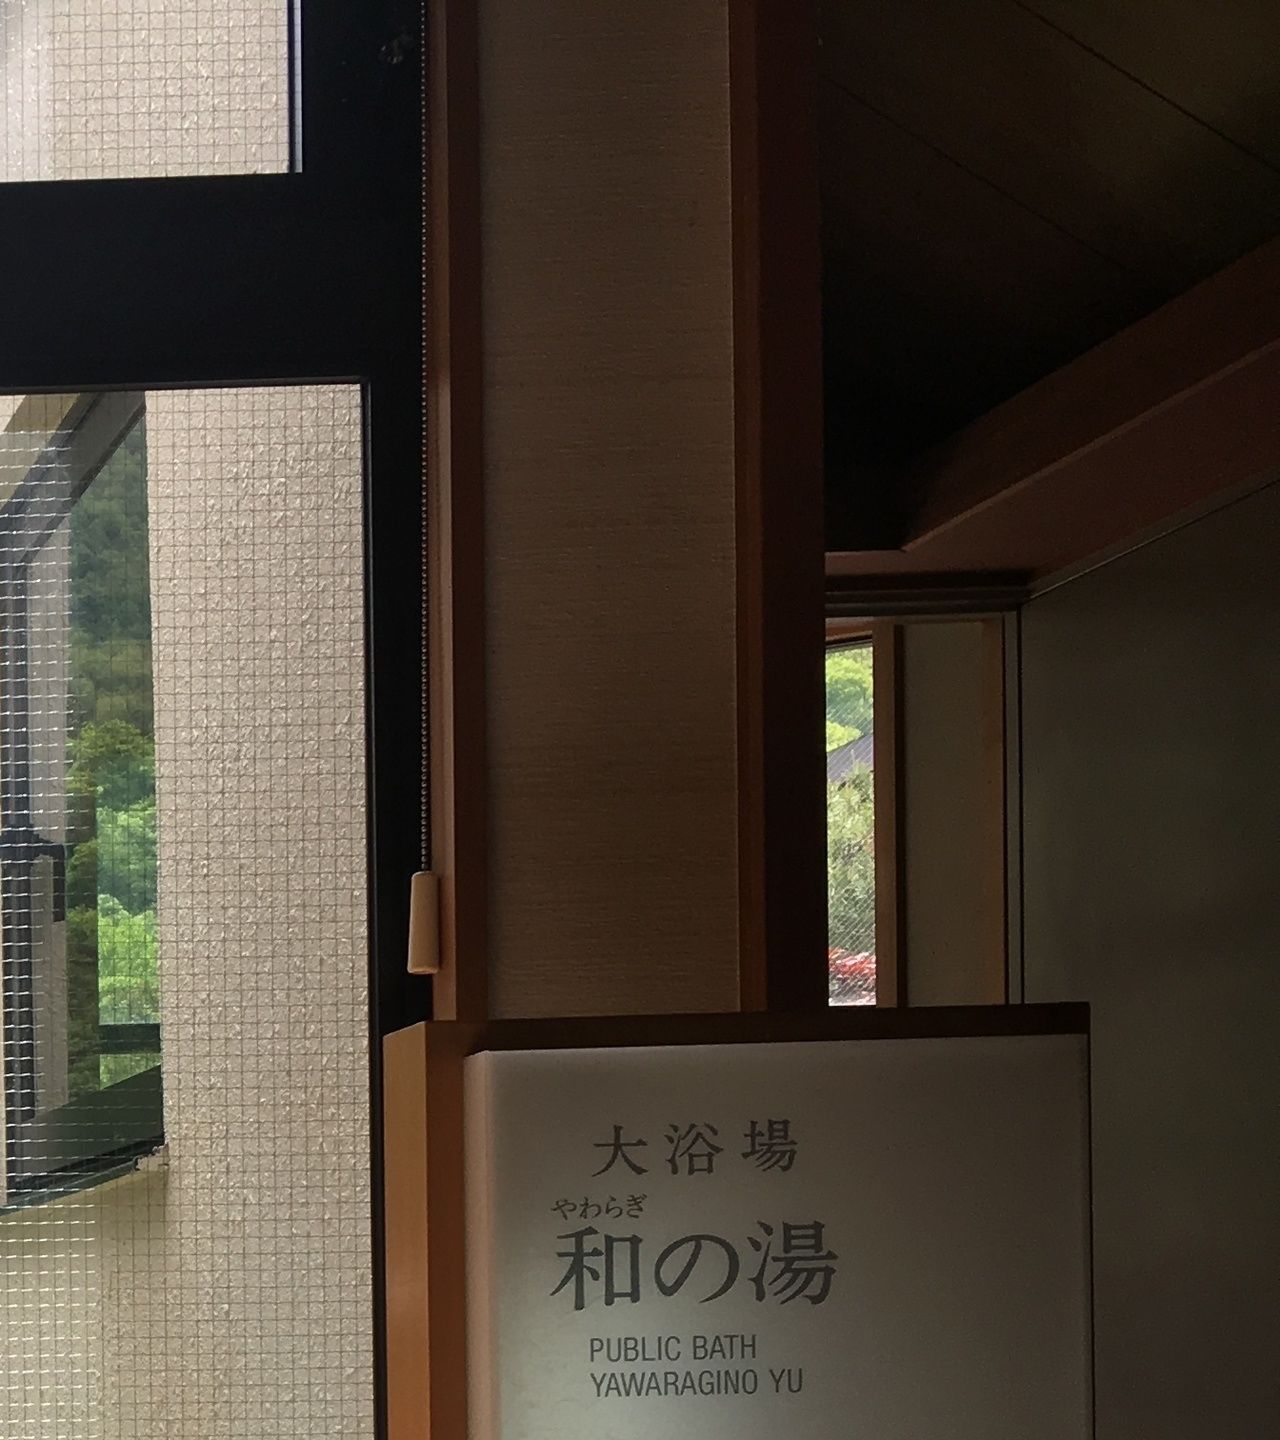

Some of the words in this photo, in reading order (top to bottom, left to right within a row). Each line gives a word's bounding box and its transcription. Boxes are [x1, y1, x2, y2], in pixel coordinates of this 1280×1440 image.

[591, 1118, 799, 1178] 大浴場
[550, 1192, 648, 1219] やわらぎ
[549, 1219, 840, 1312] 和の湯
[589, 1336, 682, 1363] PUBLIC
[692, 1334, 758, 1361] BATH
[590, 1368, 759, 1398] YAWARAGINO
[769, 1367, 804, 1394] YU
